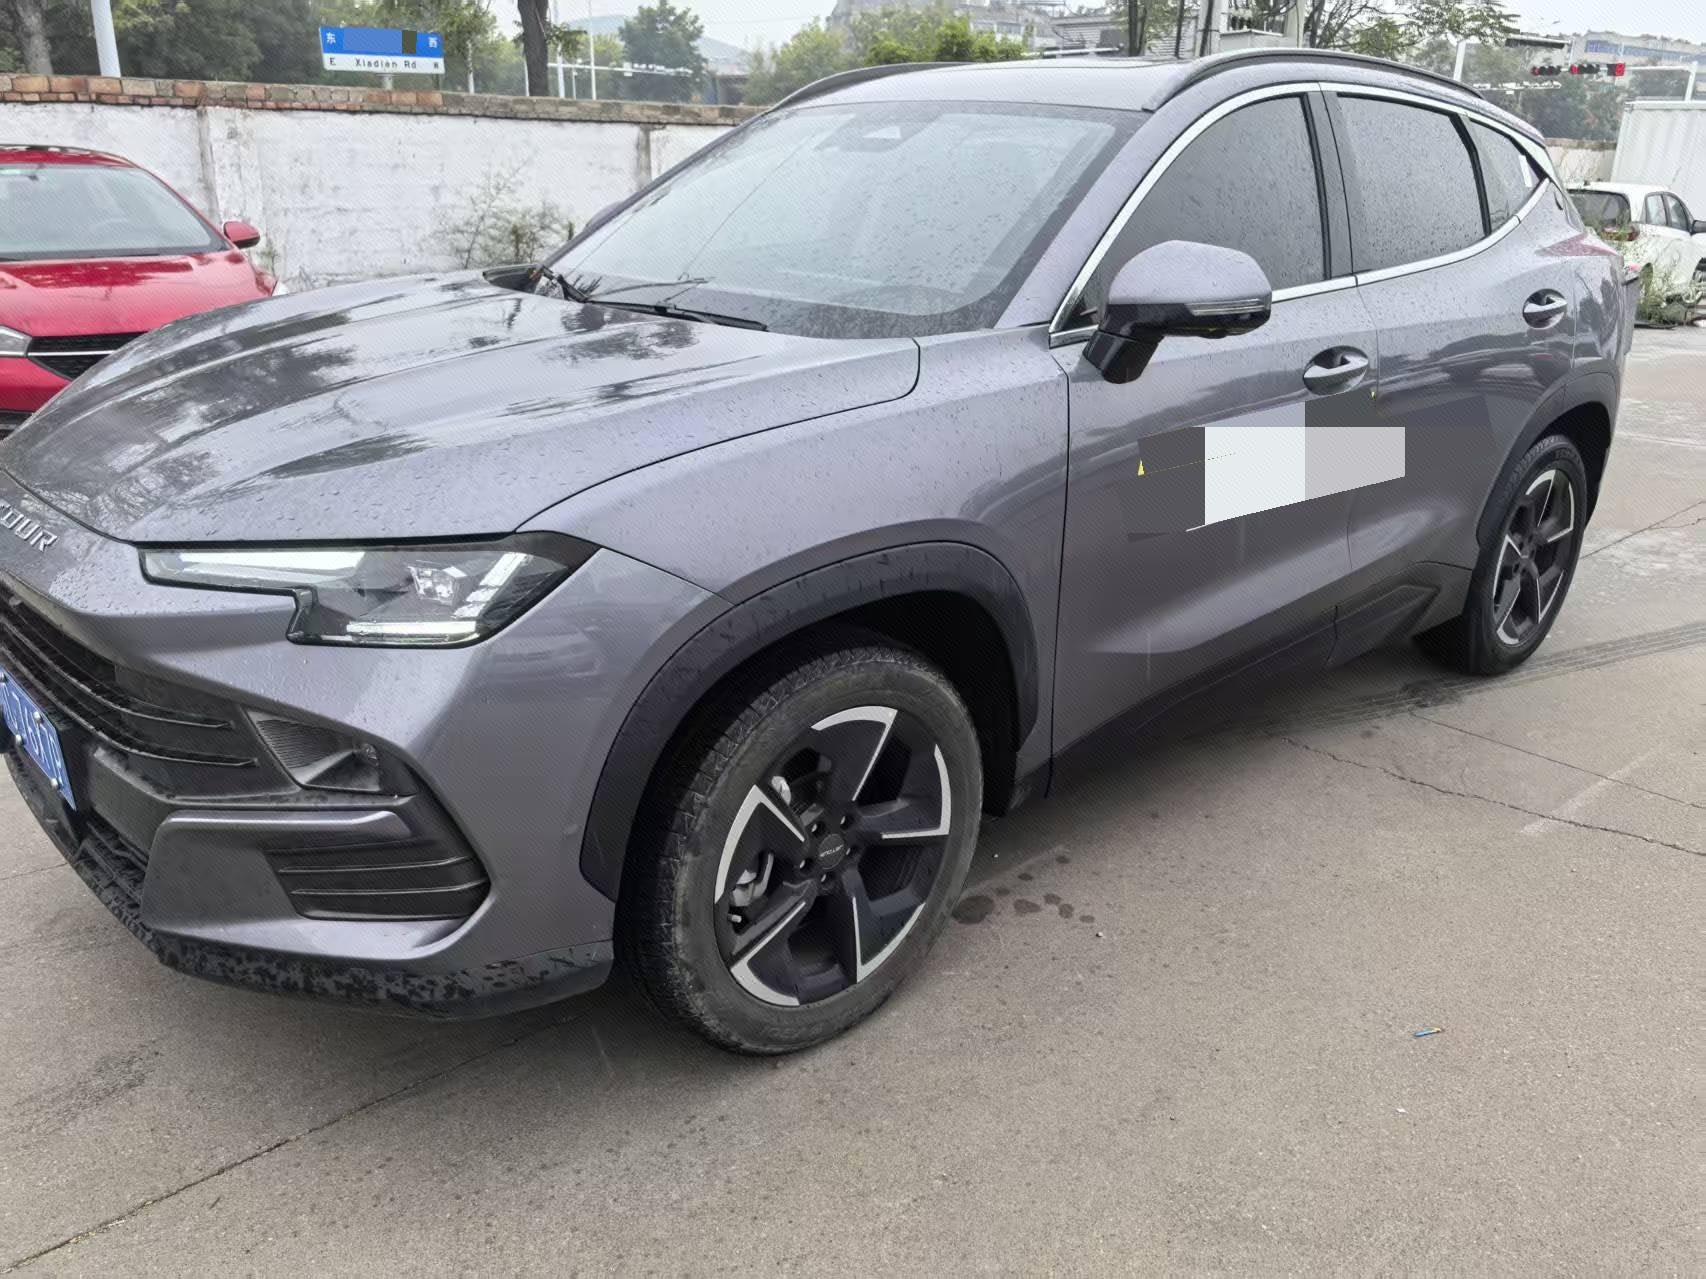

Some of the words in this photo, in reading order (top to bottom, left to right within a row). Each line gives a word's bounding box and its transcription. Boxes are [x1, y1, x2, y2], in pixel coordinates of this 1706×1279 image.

[326, 32, 337, 46] 东
[428, 38, 439, 49] 西
[329, 58, 337, 66] E
[404, 59, 417, 69] Rd
